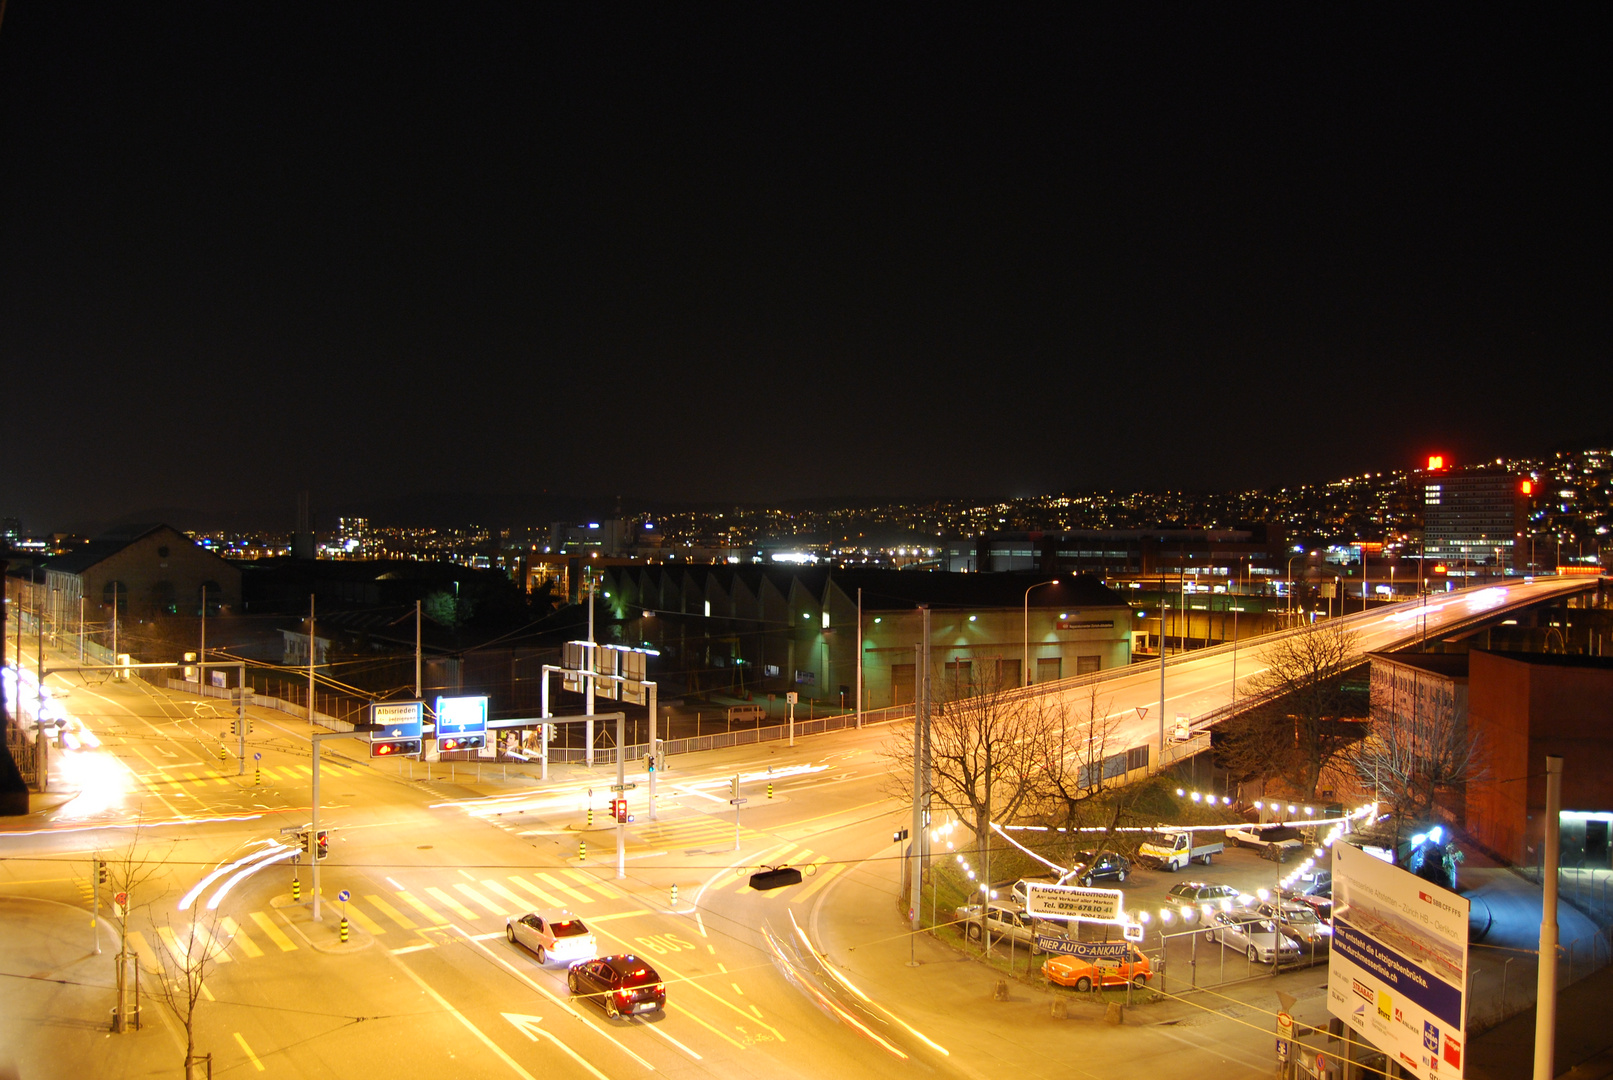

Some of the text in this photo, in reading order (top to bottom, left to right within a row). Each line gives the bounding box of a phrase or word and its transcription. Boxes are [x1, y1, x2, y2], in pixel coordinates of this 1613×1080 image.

[377, 707, 416, 715] Albisrieden
[1374, 888, 1397, 907] Altstetten
[1402, 902, 1418, 918] Zürich
[1420, 911, 1428, 923] HB
[1433, 898, 1460, 917] SBB CFF FFS
[634, 933, 696, 955] BUS
[1039, 939, 1125, 956] HIER AUTO-ANKAUF
[1334, 936, 1397, 984] www.durchmesserlinie.ch
[1345, 930, 1365, 950] entsteht
[1375, 948, 1427, 990] Letzigrabenbrücke.
[1352, 980, 1373, 1002] STRABAG
[1352, 1013, 1363, 1028] LOCHER
[1402, 1019, 1418, 1035] ANLIKER
[1424, 1029, 1437, 1045] KIBAG
